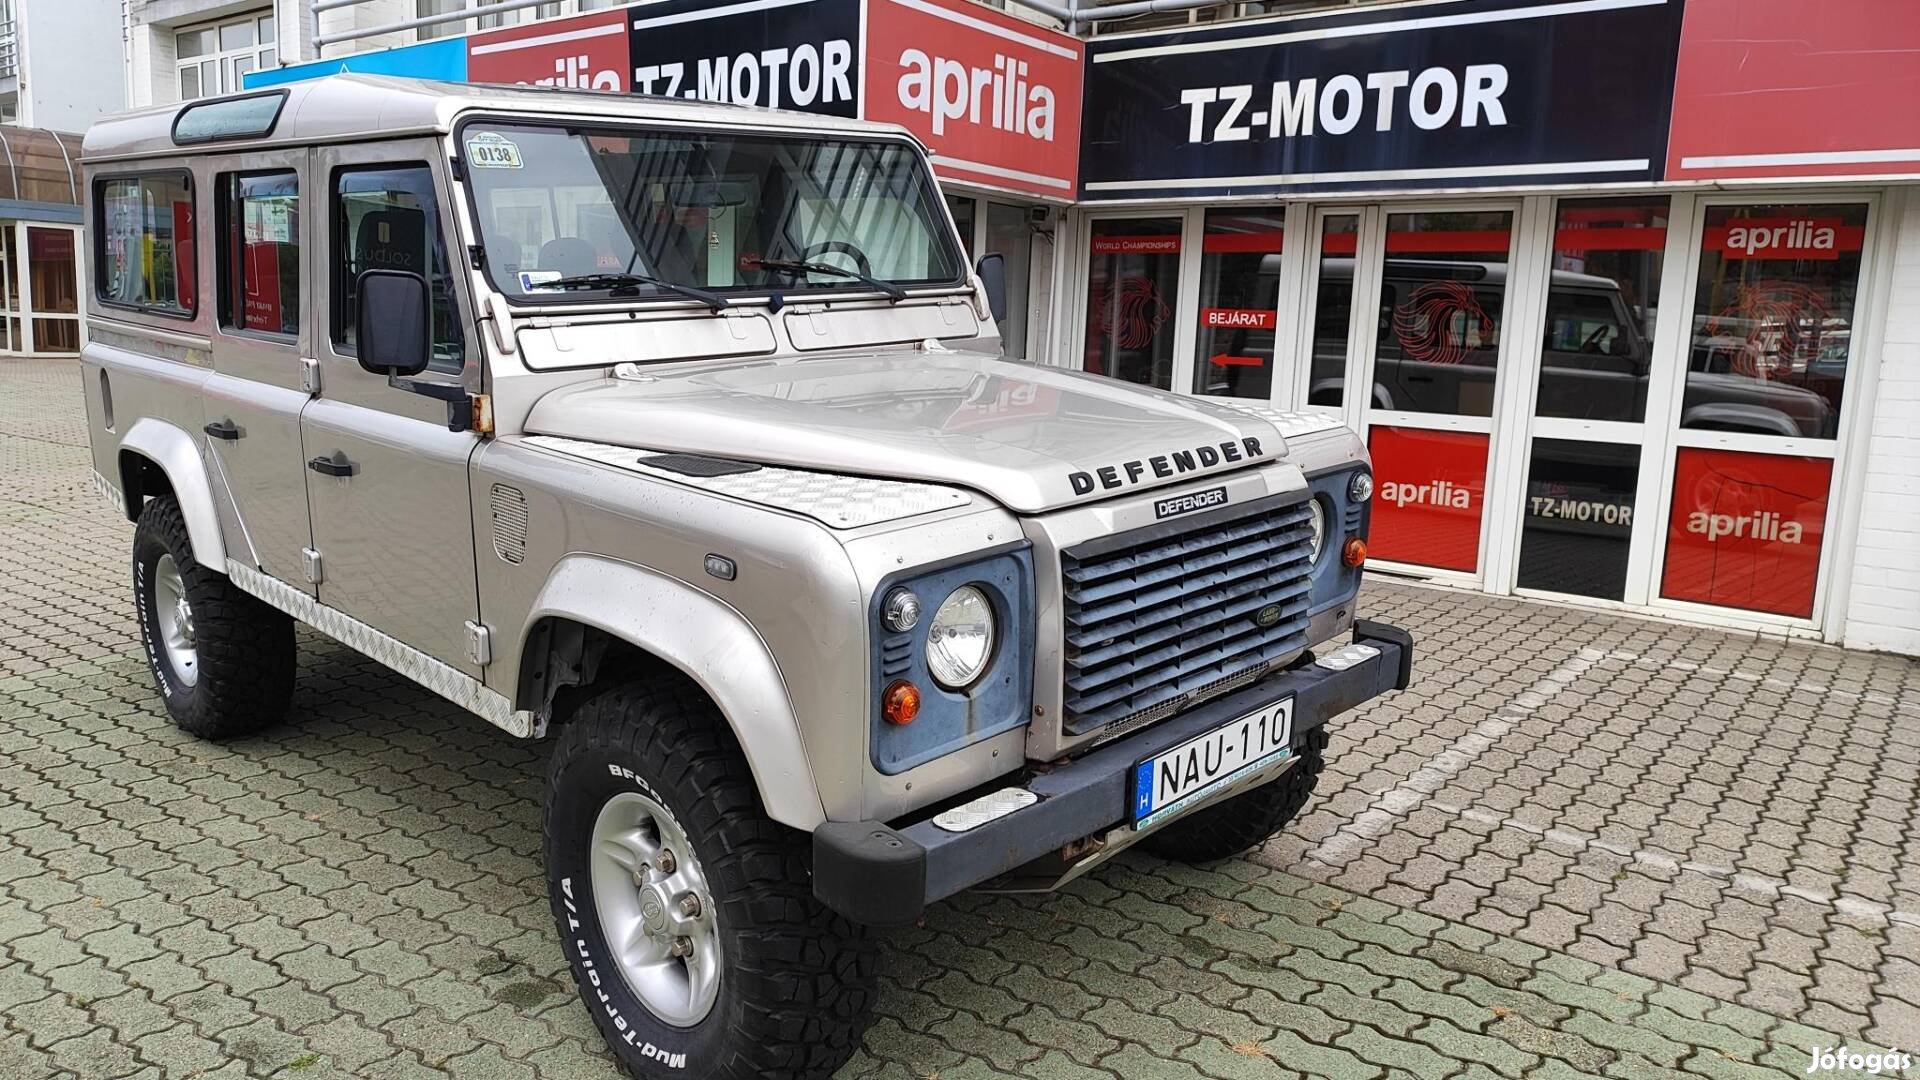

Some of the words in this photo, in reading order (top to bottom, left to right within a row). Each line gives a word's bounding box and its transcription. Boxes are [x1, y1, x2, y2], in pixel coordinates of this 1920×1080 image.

[634, 40, 853, 108] TZ-MOTOR
[897, 48, 1056, 142] aprilia
[1180, 63, 1509, 144] TZ-MOTOR
[478, 147, 512, 161] 0138
[1726, 220, 1835, 255] aprilia
[1208, 311, 1266, 325] BEJÁRAT
[1068, 436, 1264, 496] DEFENDER
[1159, 489, 1224, 517] DEFENDER
[1381, 480, 1470, 509] aprilia
[1531, 496, 1632, 526] TZ-MOTOR
[1687, 510, 1802, 544] aprilia
[1160, 707, 1287, 801] NAU-110
[1139, 794, 1149, 810] H
